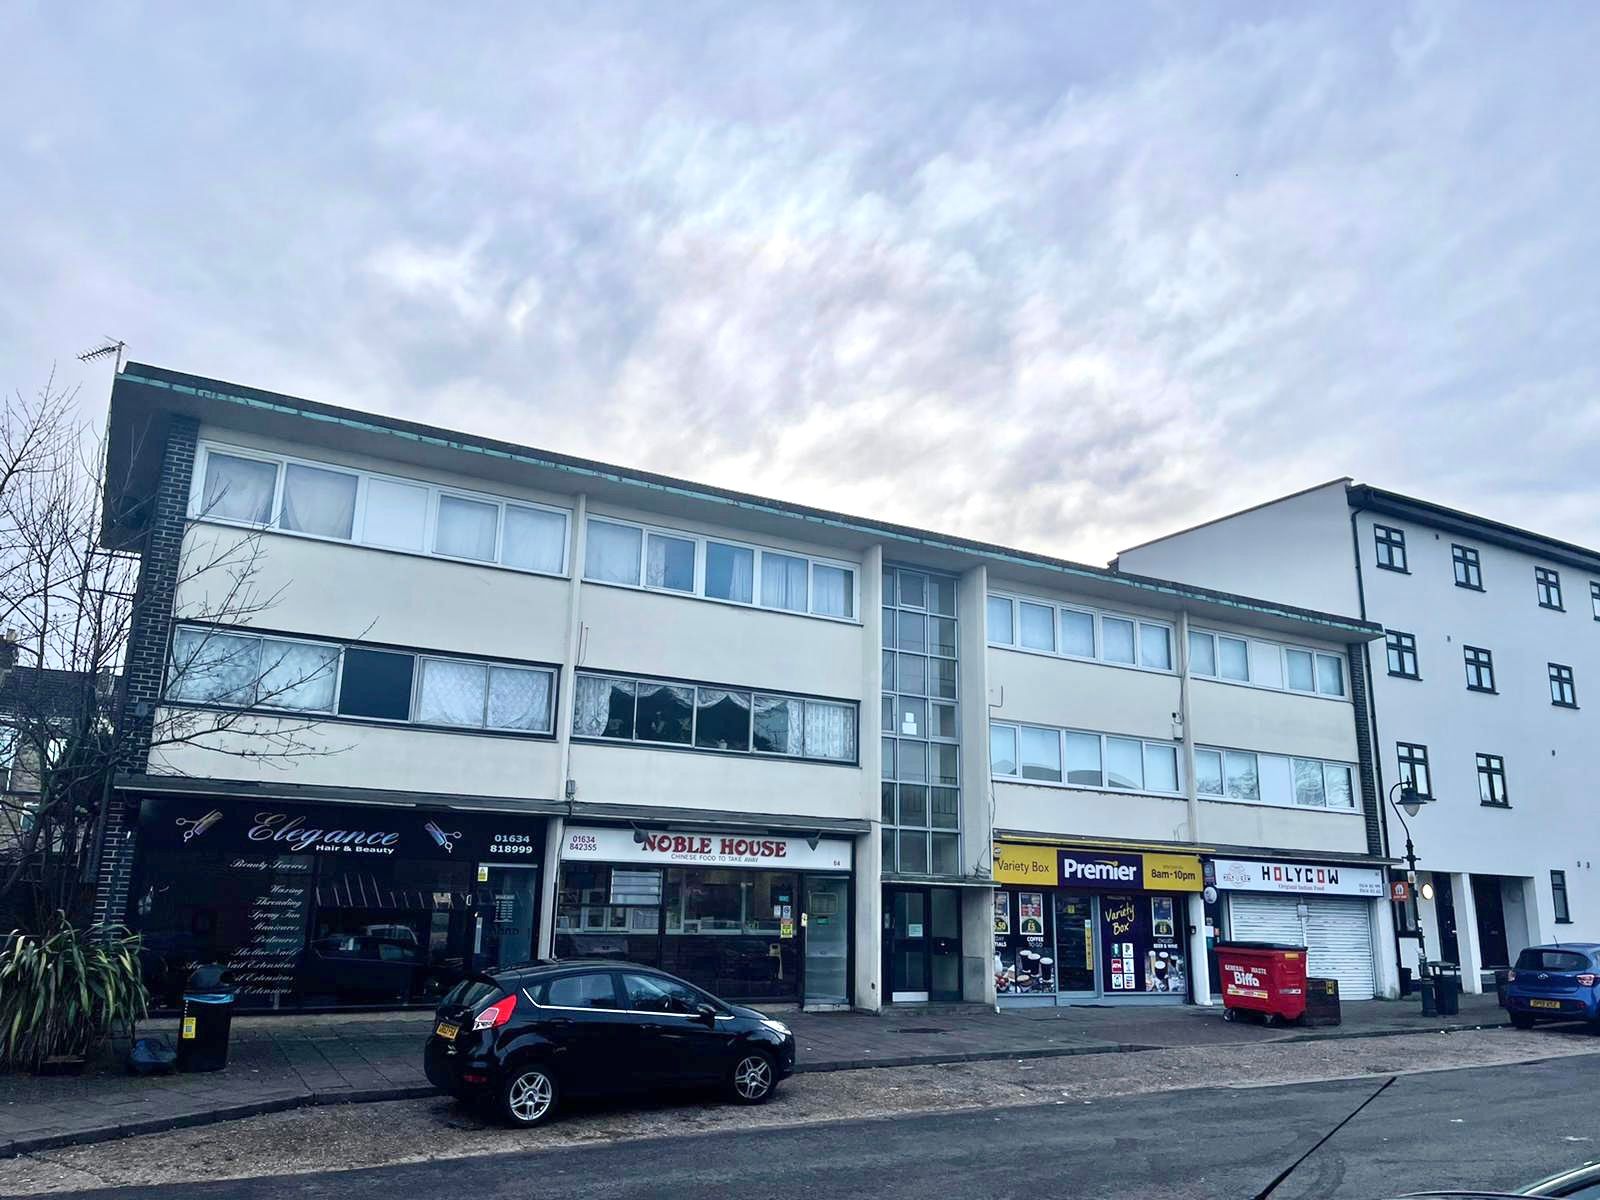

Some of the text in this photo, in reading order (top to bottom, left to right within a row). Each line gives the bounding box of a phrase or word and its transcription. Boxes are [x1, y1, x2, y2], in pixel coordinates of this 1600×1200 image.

[248, 812, 399, 851] Elegance
[494, 834, 531, 843] 01634
[572, 835, 596, 844] 01634
[355, 846, 395, 854] Beauty
[489, 844, 533, 853] 818999
[641, 834, 787, 858] NOBLE HOUSE
[230, 858, 268, 870] Beauty
[671, 853, 697, 861] CHINESE
[699, 854, 716, 862] FOOD
[998, 859, 1050, 875] Variety Box
[1063, 858, 1137, 880] Premier
[1105, 902, 1135, 922] Variety
[1112, 922, 1130, 935] Box
[1233, 971, 1260, 987] Biffa
